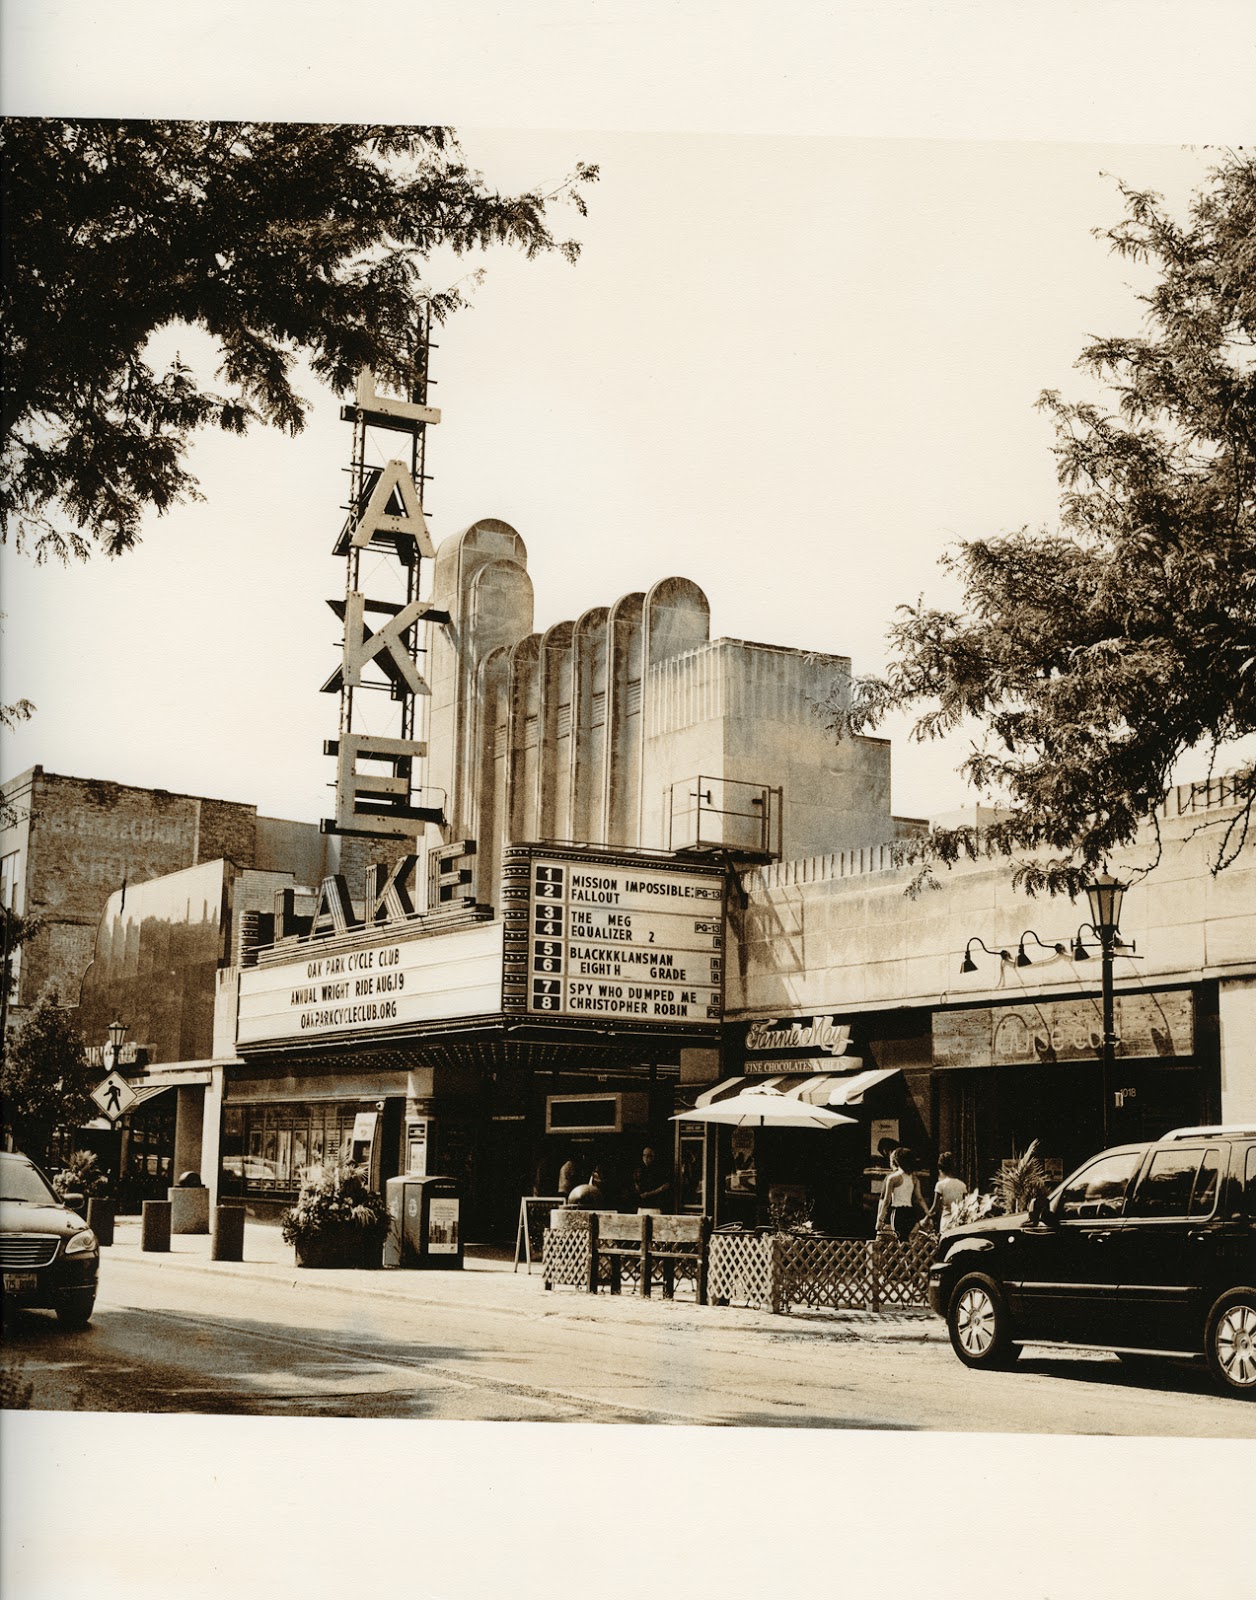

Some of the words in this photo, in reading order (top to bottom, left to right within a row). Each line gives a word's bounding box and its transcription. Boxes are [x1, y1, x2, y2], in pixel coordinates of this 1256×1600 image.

[336, 360, 441, 836] LAKE
[544, 868, 552, 881] 1
[273, 839, 478, 948] LAKE
[543, 884, 555, 897] 2
[572, 875, 617, 891] MISSION
[625, 880, 695, 899] IMPOSSIBLE:
[696, 889, 721, 899] PG-13
[571, 889, 620, 904] FALLOUT
[544, 906, 555, 919] 3
[543, 921, 555, 935] 4
[571, 911, 592, 924] THE
[608, 914, 631, 927] MEG
[695, 923, 721, 933] PG-13
[571, 926, 633, 941] EQUALIZER
[648, 932, 655, 943] 2
[543, 942, 554, 955] 5
[570, 947, 673, 967] BLACKKKLANSMAN
[307, 961, 323, 979] OAK
[325, 958, 345, 976] PARK
[348, 952, 374, 971] CYCLE
[378, 948, 400, 967] CLUB
[542, 958, 553, 972] 6
[650, 967, 687, 981] GRADE
[290, 987, 318, 1006] ANNUAL
[321, 982, 350, 1002] WRIGHT
[355, 978, 373, 997] RIDE
[542, 980, 552, 993] 7
[569, 983, 593, 995] SPY
[599, 985, 622, 999] WHO
[628, 987, 674, 1002] DUMPED
[680, 991, 696, 1004] ME
[541, 996, 552, 1010] 8
[569, 997, 648, 1014] CHRISTOPHER
[654, 1003, 688, 1017] ROBIN
[300, 1001, 397, 1029] OAKPARKCYCLECLUB.ORG
[745, 1019, 801, 1050] Fannie
[800, 1015, 854, 1055] May
[745, 1061, 763, 1073] FINE
[763, 1060, 813, 1072] CHOCOLATES
